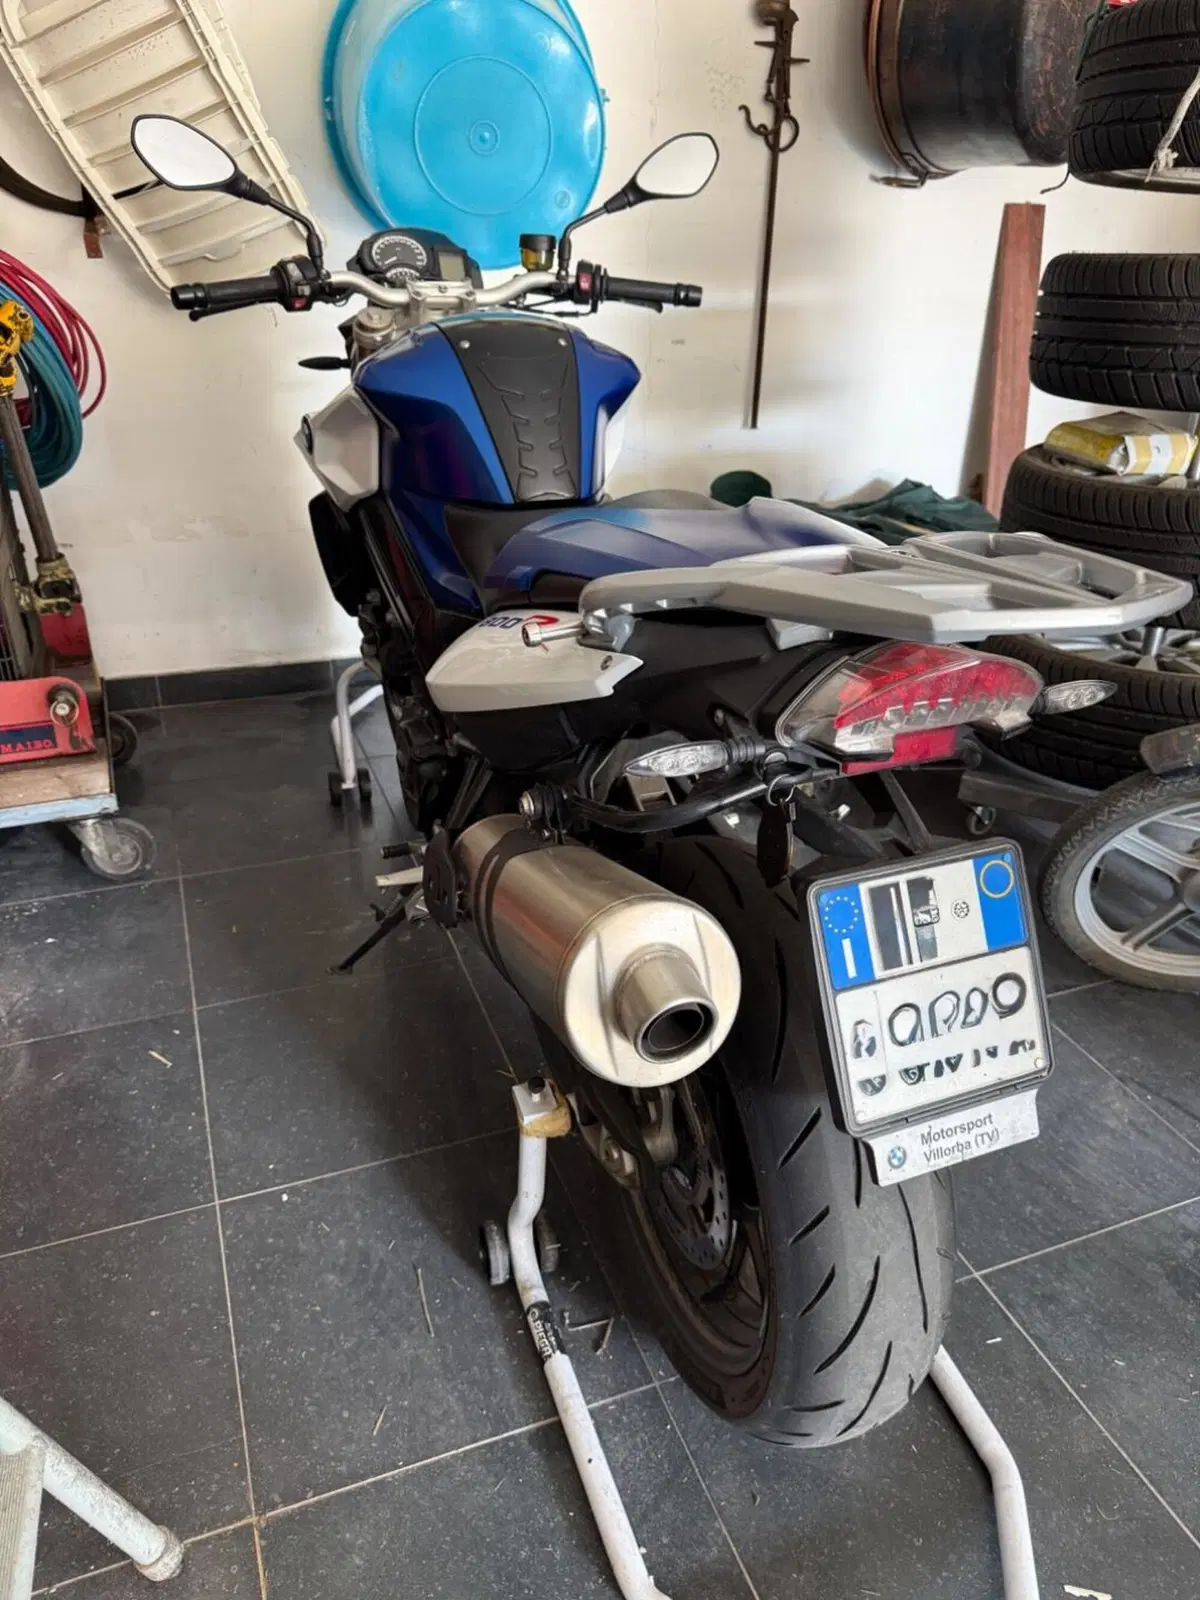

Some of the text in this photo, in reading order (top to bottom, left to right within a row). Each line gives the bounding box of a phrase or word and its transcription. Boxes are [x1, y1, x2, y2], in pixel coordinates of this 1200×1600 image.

[921, 1113, 993, 1145] Motorsport
[923, 1140, 971, 1162] Villorba
[974, 1127, 1000, 1148] (TV)
